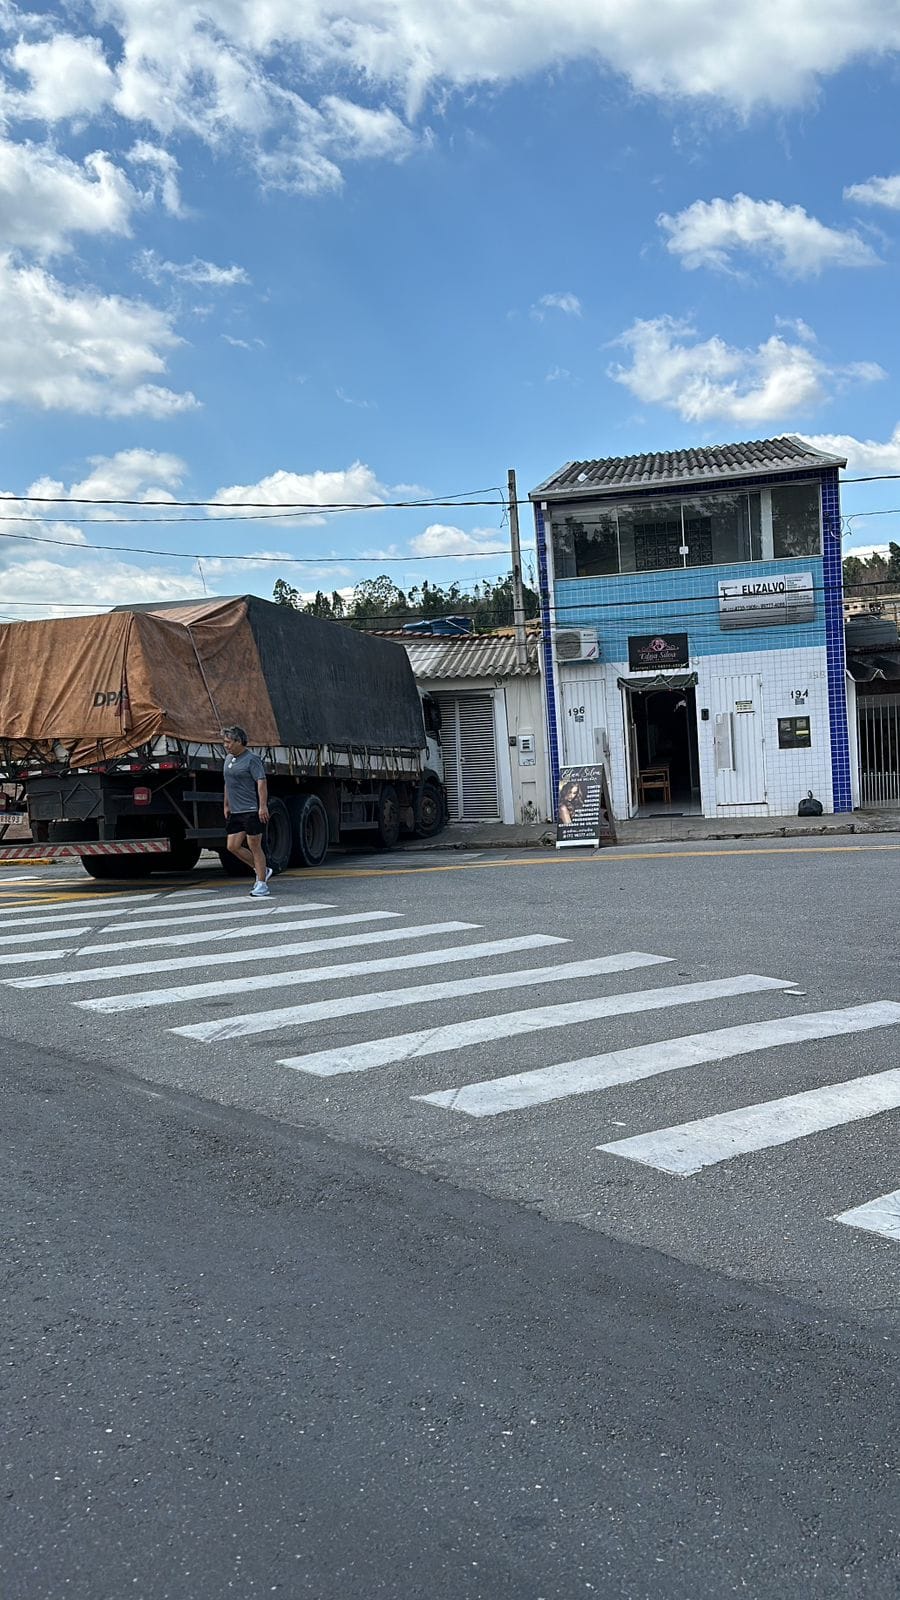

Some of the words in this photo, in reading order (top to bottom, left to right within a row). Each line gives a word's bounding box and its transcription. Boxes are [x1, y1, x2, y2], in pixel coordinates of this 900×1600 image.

[742, 582, 785, 595] ELIZALVO
[791, 689, 809, 699] 194
[568, 706, 585, 717] 196
